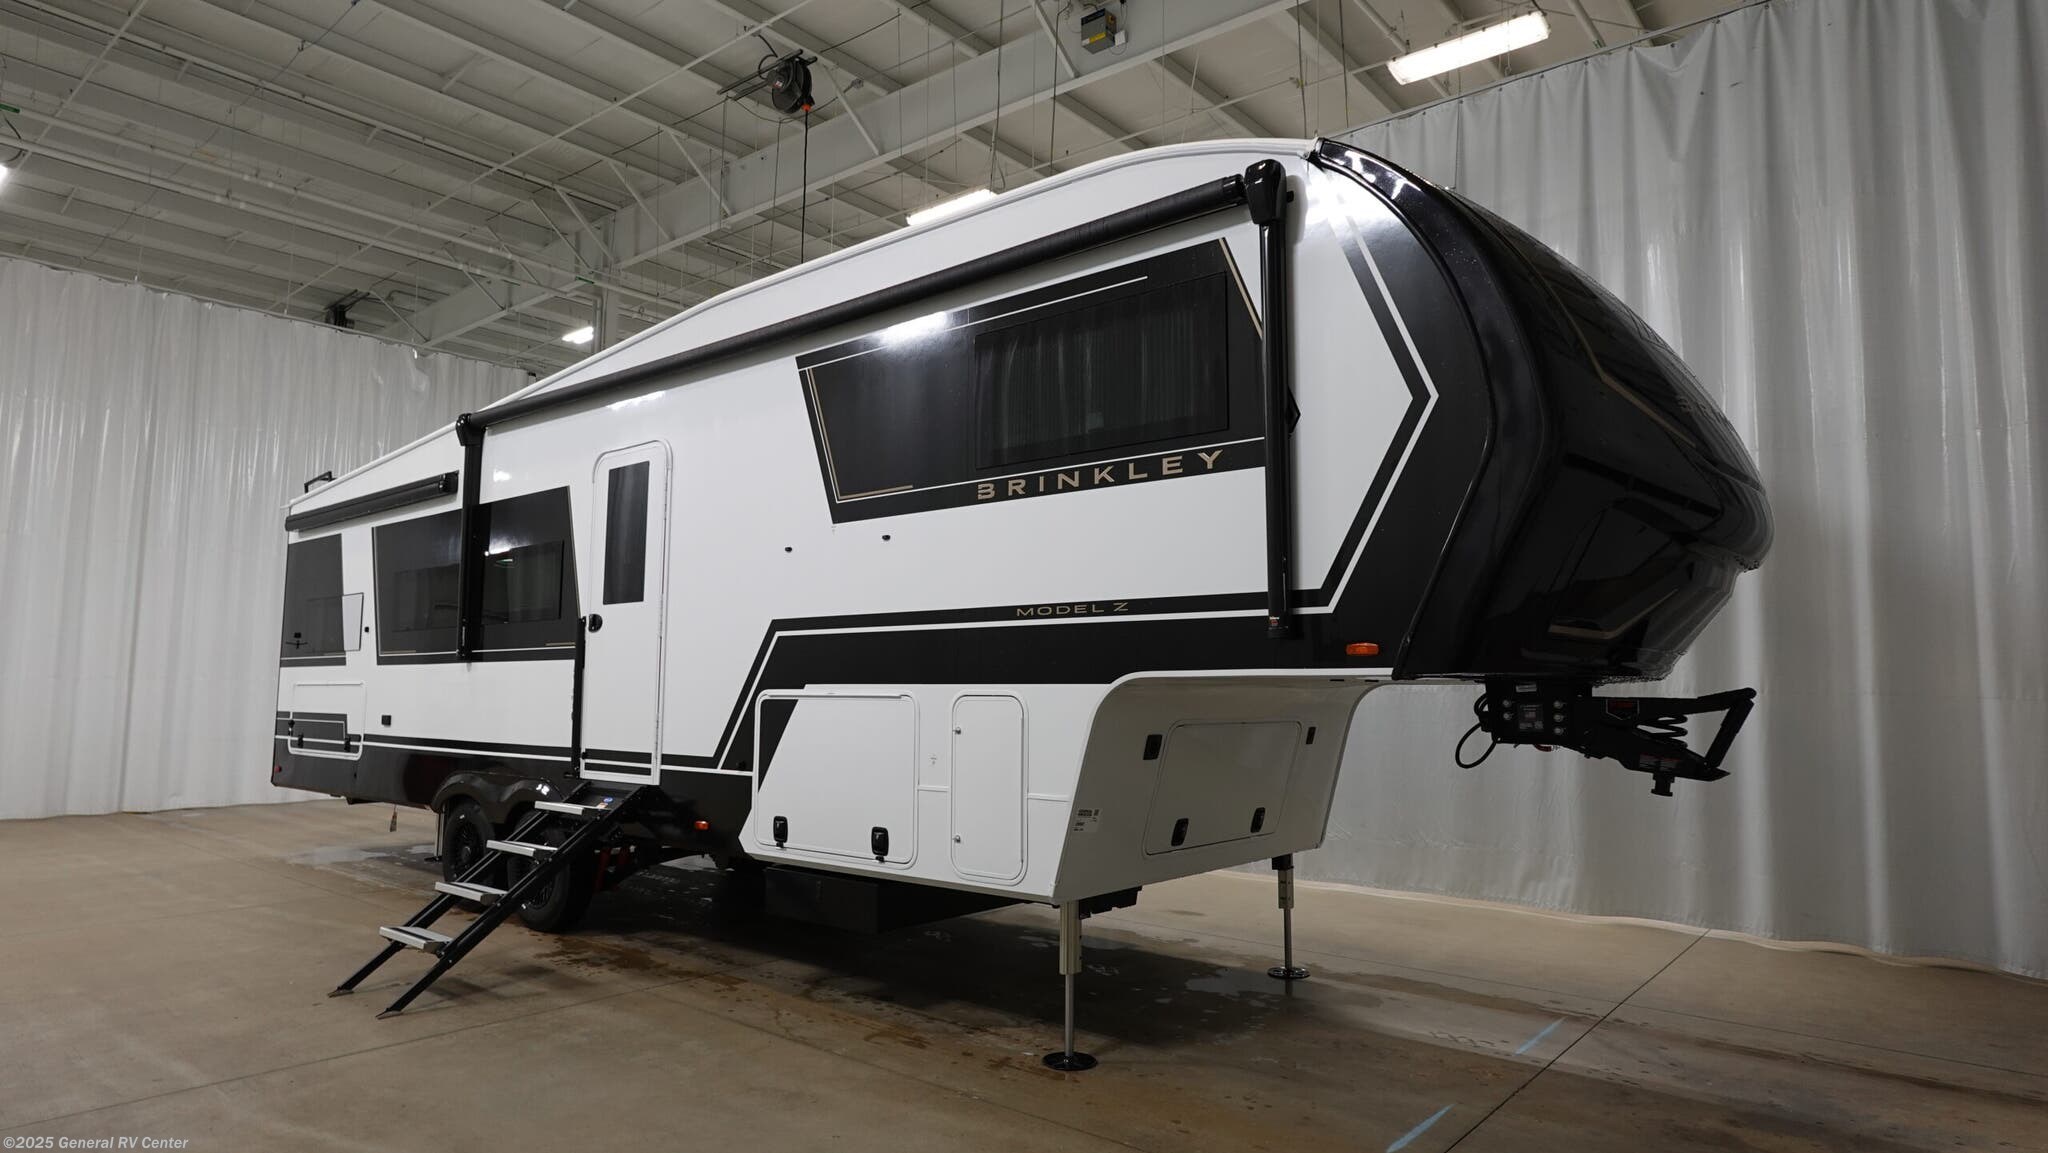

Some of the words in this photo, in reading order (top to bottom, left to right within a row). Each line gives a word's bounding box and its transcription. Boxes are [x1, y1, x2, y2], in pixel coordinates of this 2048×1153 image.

[977, 450, 1223, 500] BRINKLEY
[1016, 604, 1104, 617] MODEL
[1113, 602, 1129, 612] Z
